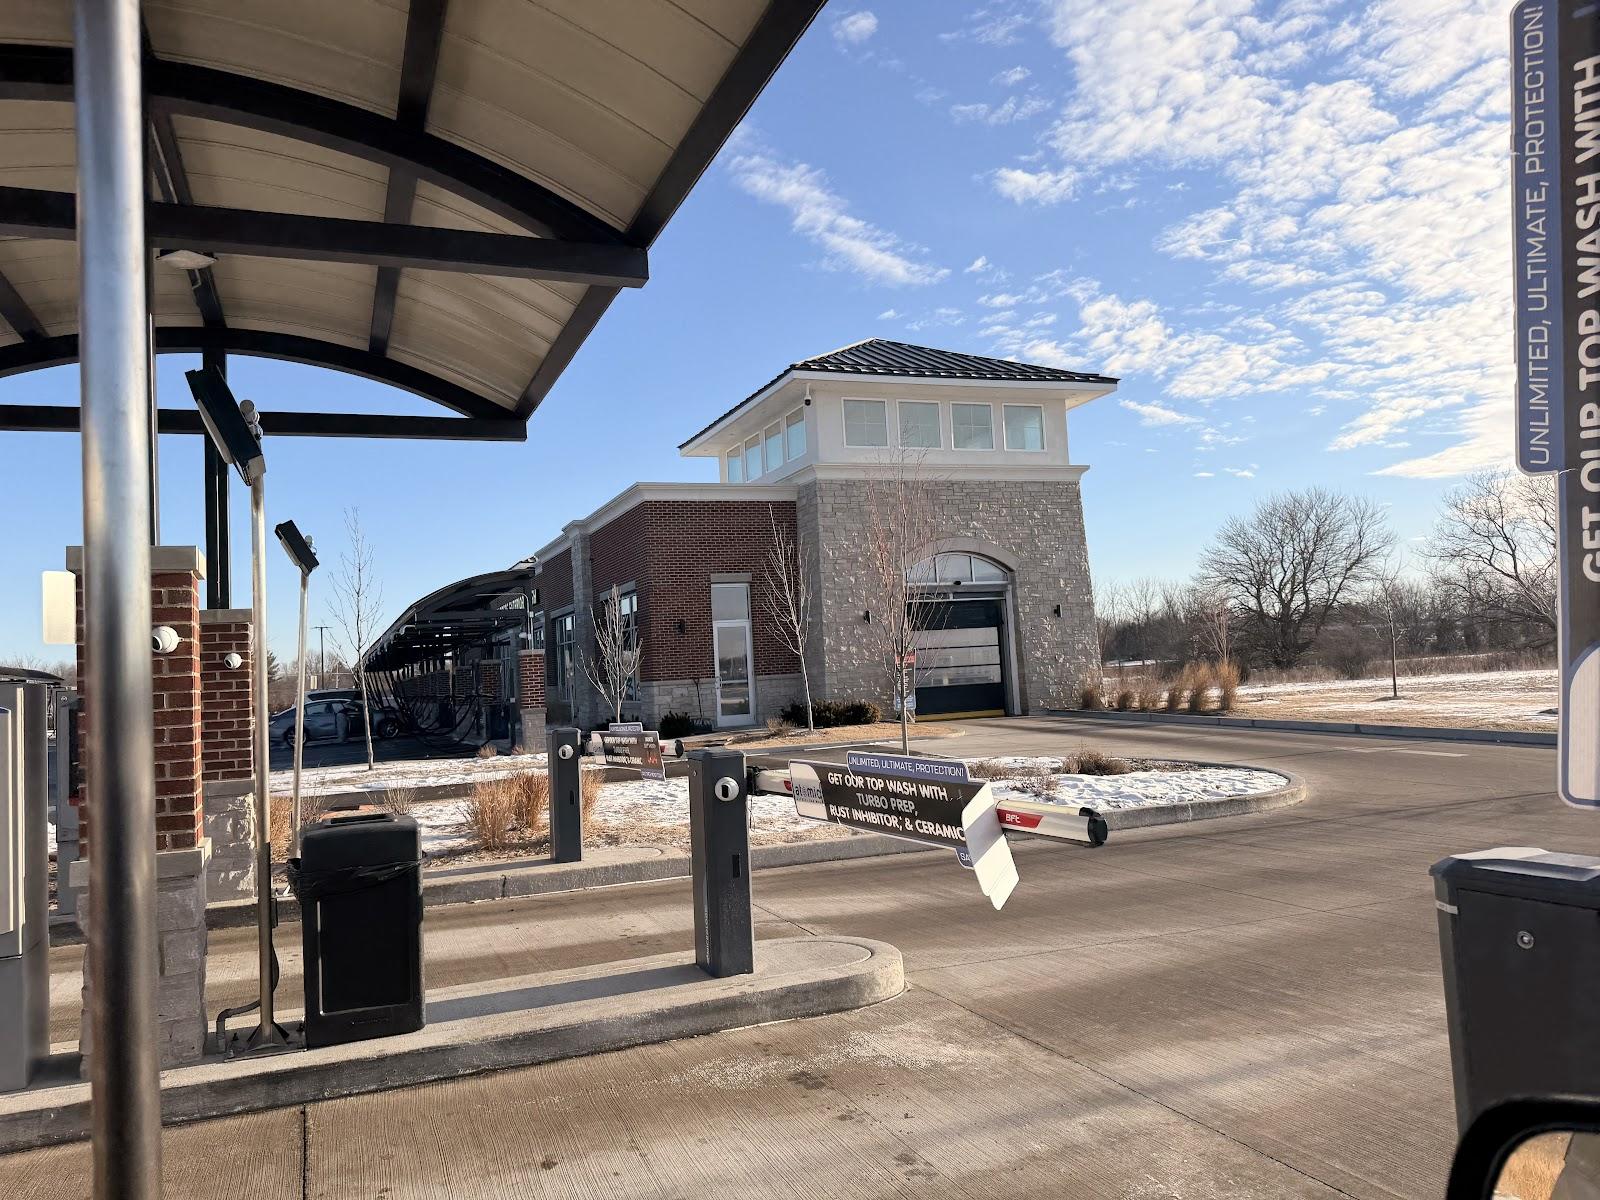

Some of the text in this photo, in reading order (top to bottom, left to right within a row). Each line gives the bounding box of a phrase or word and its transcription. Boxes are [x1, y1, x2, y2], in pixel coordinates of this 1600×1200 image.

[1574, 53, 1600, 164] WITH
[1523, 5, 1552, 465] UNLIMITED, ULTIMATE, PROTECTION!
[1575, 172, 1600, 299] WASH
[1578, 309, 1600, 392] TOP
[828, 773, 948, 802] GET OUR TOP WASH WITH
[848, 756, 965, 777] UNLIMITED, ULTIMATE, PROTECTION!
[829, 804, 966, 841] RUST INHIBITOR, & CERAMIC
[856, 792, 918, 816] TURBO PREP,
